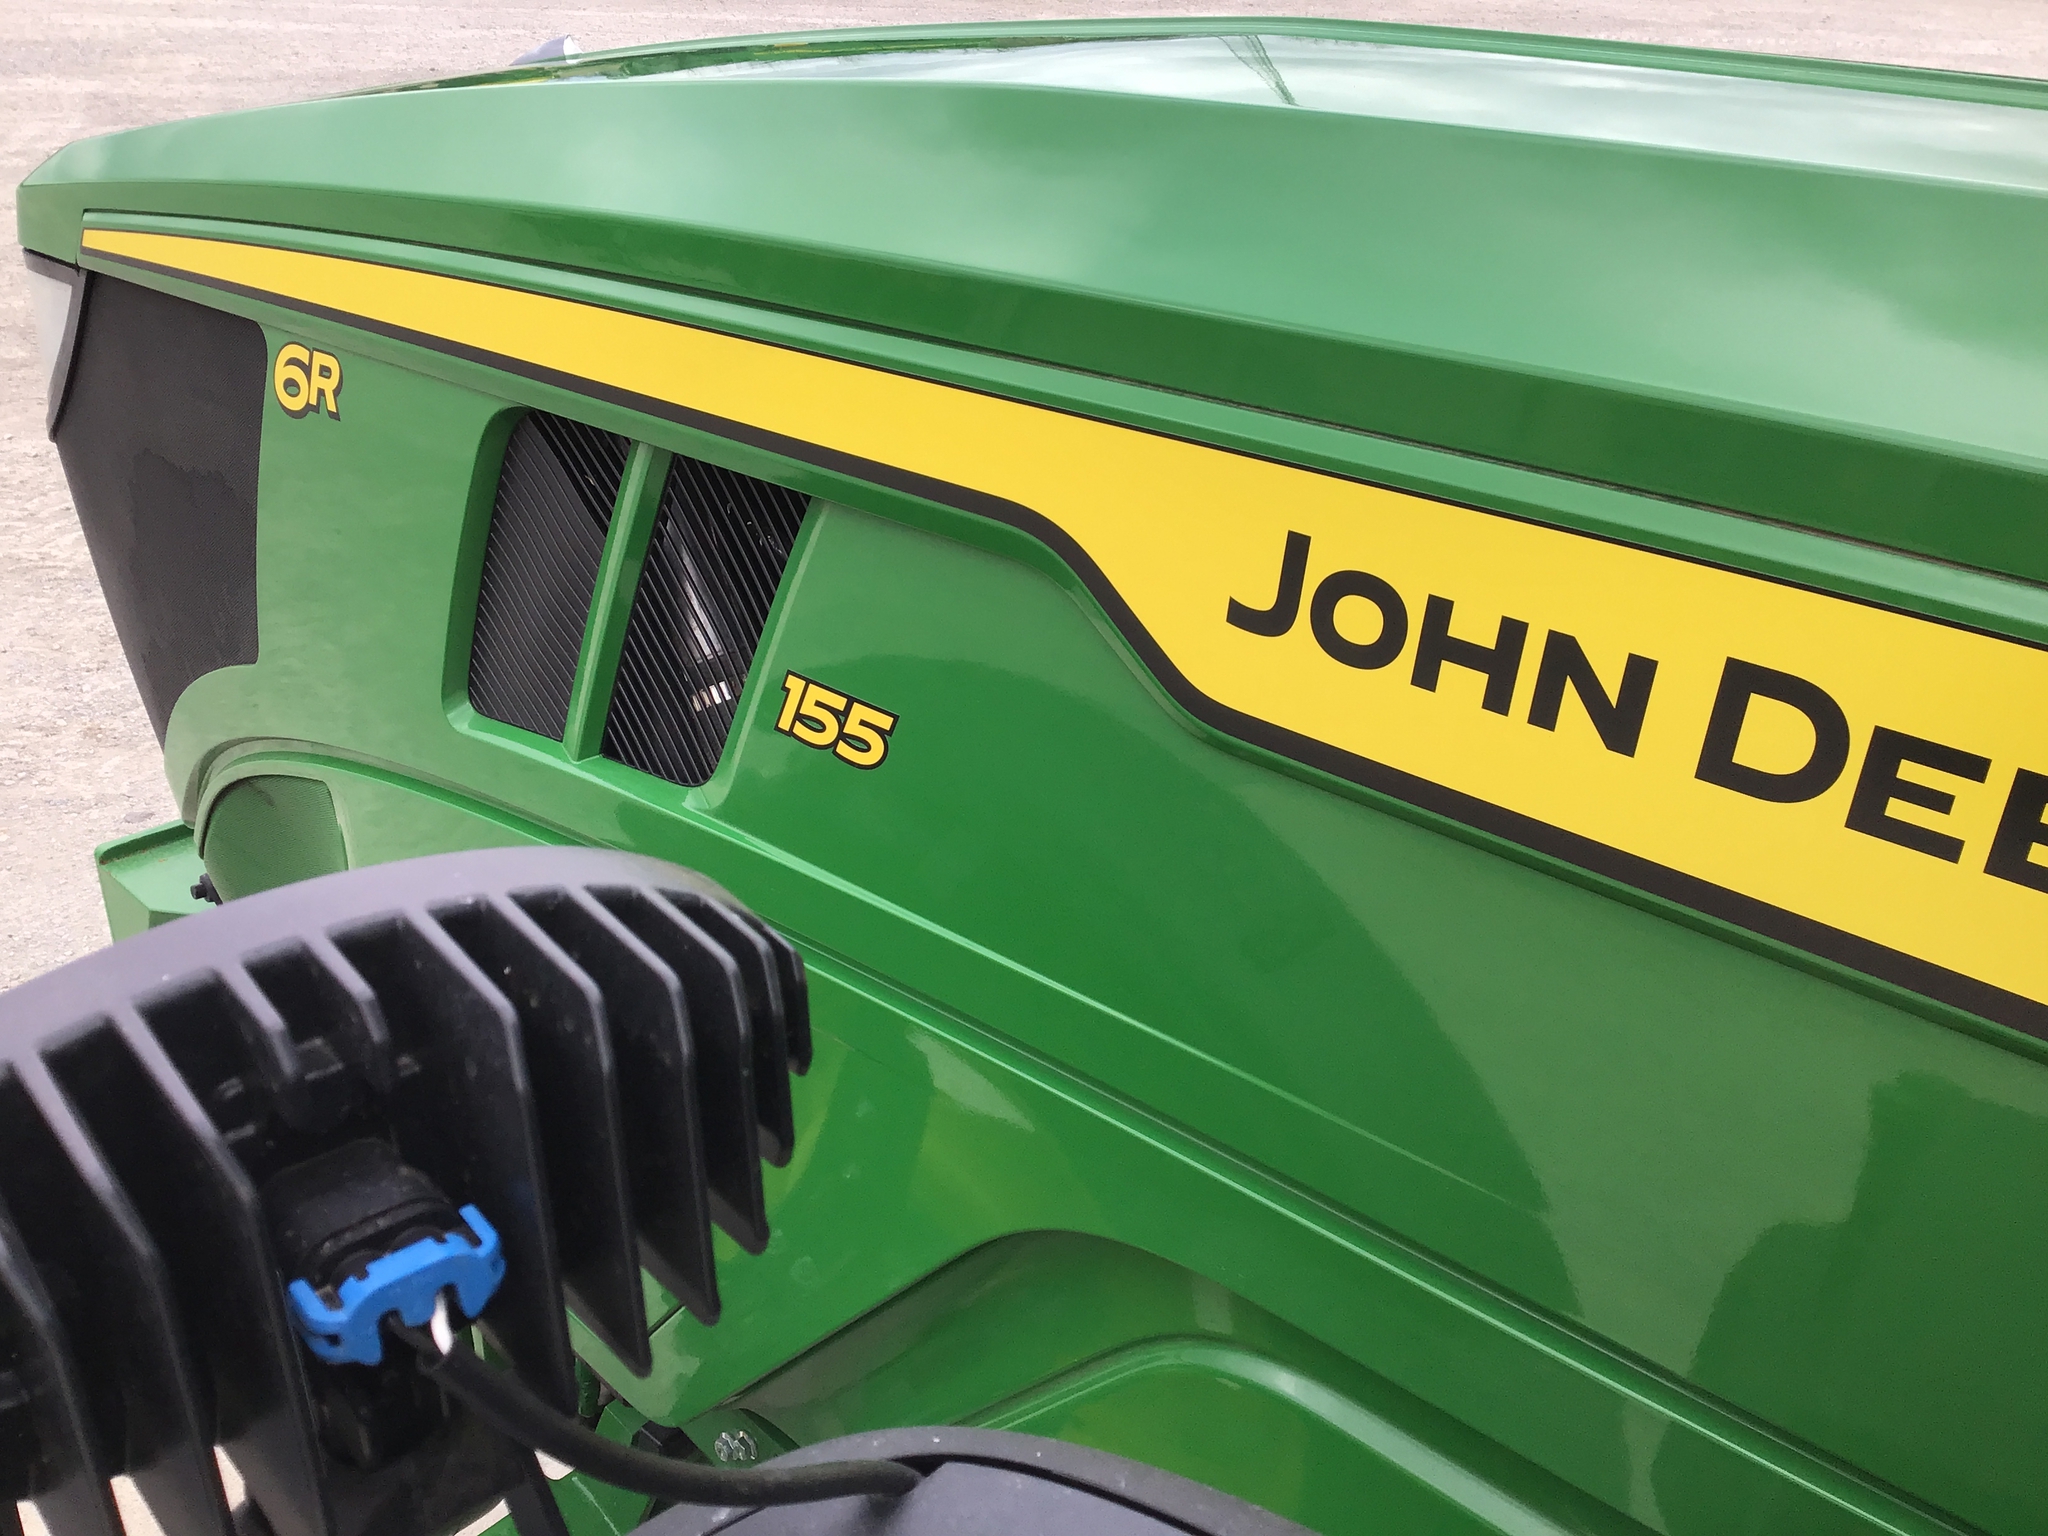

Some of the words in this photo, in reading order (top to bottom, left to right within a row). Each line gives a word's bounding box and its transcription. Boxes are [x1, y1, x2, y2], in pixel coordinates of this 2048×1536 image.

[274, 342, 343, 420] 6R
[1226, 530, 1658, 758] JOHN
[774, 670, 900, 770] 155
